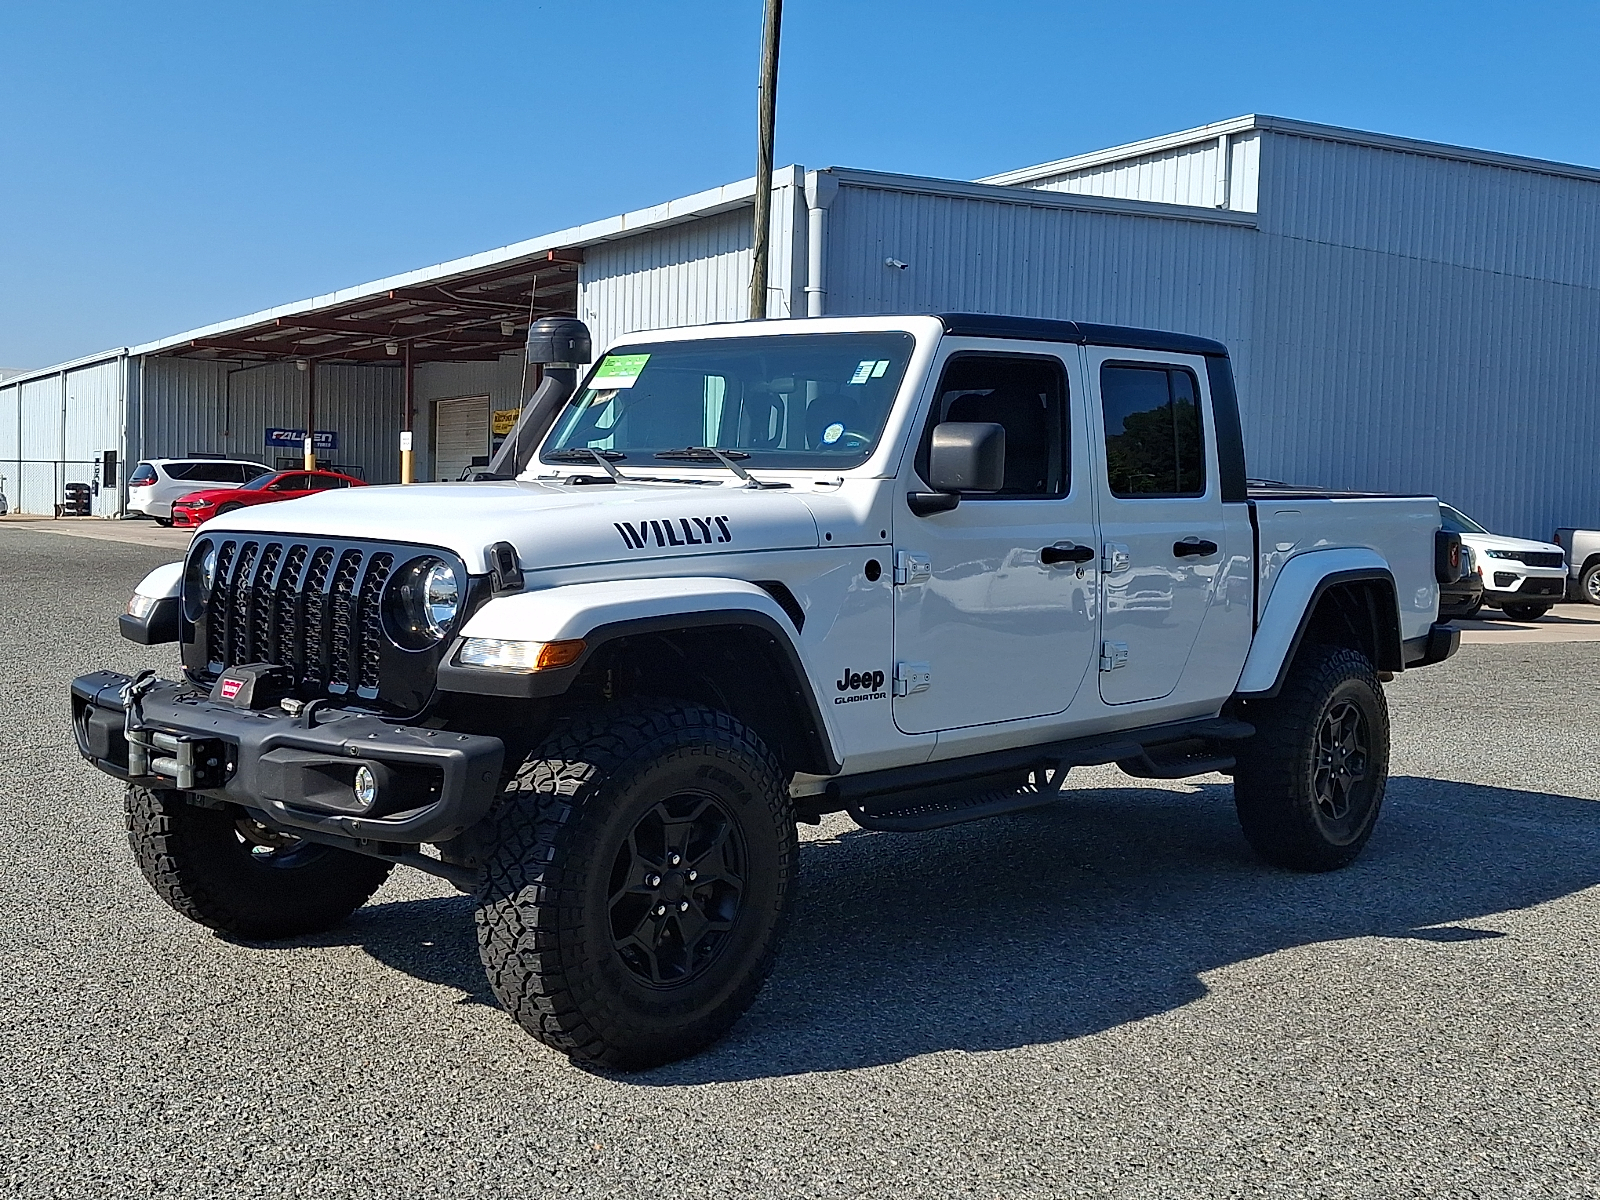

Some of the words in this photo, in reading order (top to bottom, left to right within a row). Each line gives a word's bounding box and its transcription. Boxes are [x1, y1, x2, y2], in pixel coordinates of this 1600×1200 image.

[613, 515, 732, 550] WILLYS
[836, 668, 885, 692] Jeep
[834, 692, 887, 705] GLADIATOR
